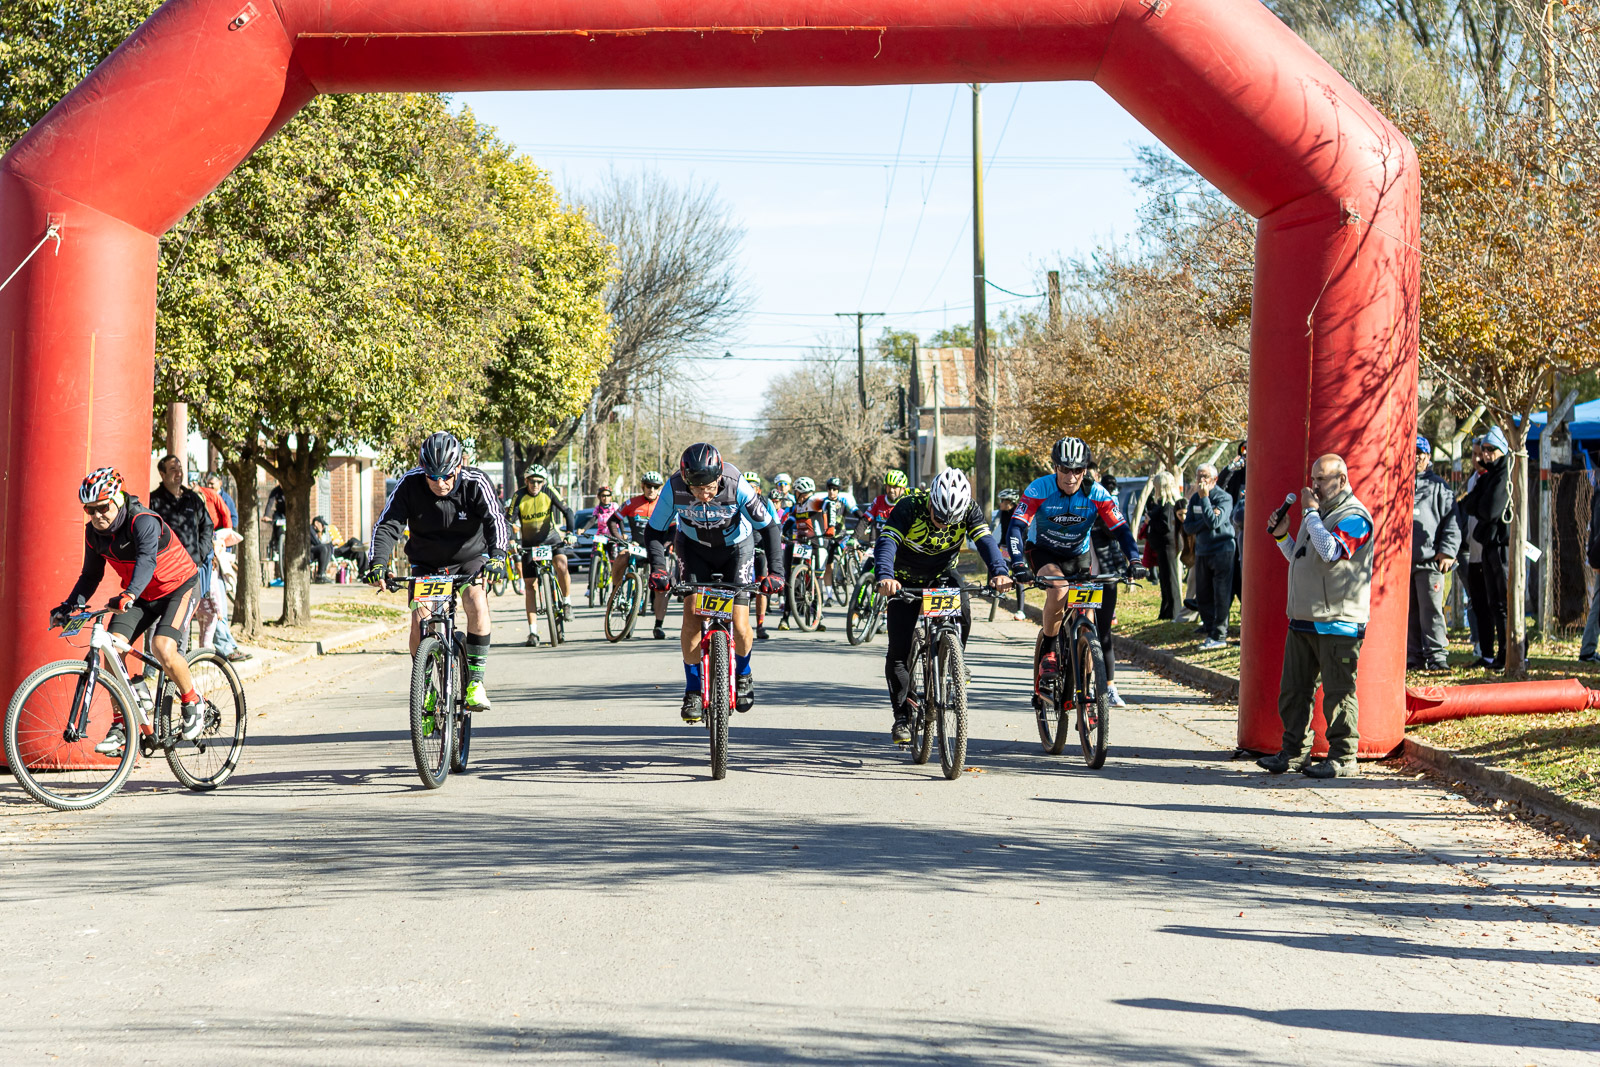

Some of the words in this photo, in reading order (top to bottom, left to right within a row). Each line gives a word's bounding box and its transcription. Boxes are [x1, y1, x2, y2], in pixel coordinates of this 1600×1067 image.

[677, 508, 706, 519] PINI
[420, 582, 447, 596] 35
[701, 595, 731, 612] 167
[930, 595, 955, 610] 93
[1075, 590, 1095, 603] 51
